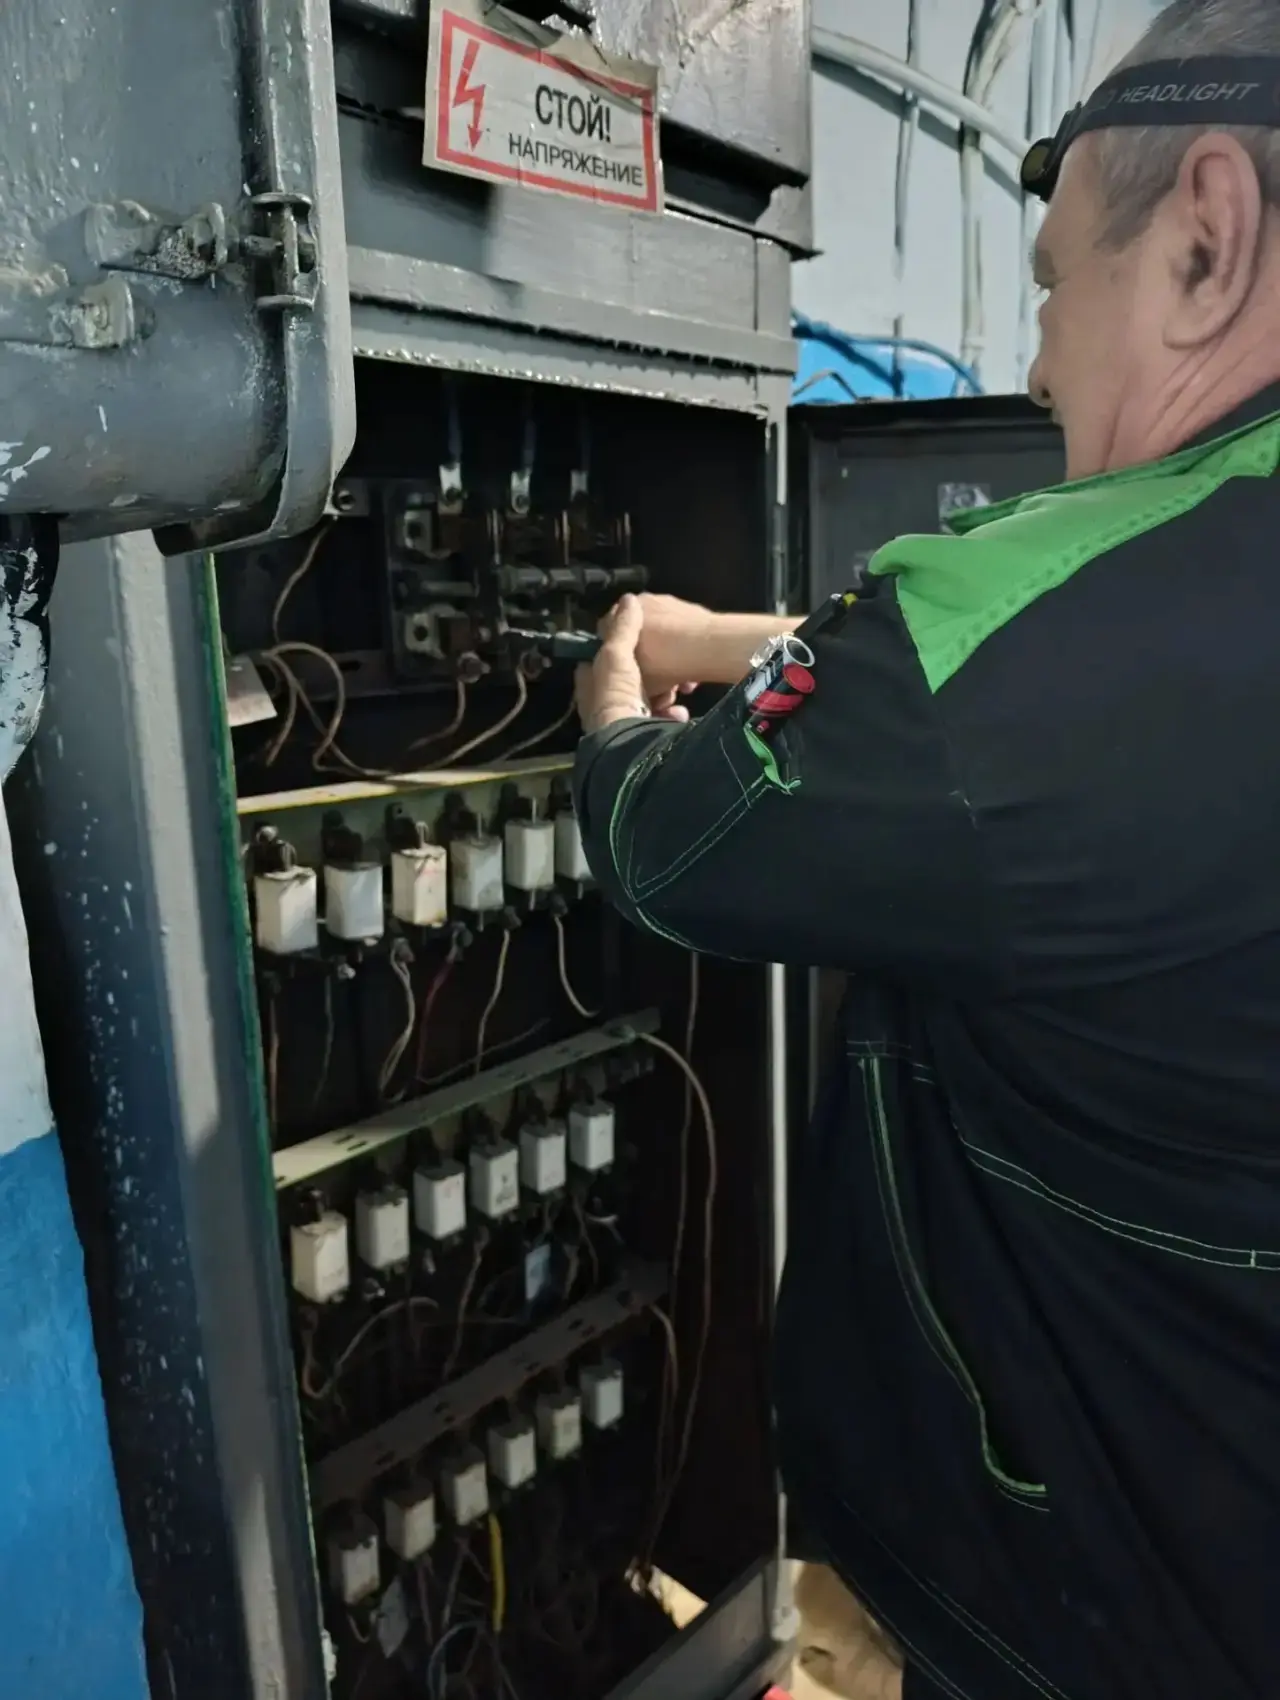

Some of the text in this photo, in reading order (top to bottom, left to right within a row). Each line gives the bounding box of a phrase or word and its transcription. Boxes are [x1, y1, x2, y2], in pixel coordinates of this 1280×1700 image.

[535, 84, 611, 142] СТОЙ!
[1118, 83, 1260, 103] HEADLIGHT
[508, 133, 644, 187] НАПРЯЖЕНИЕ
